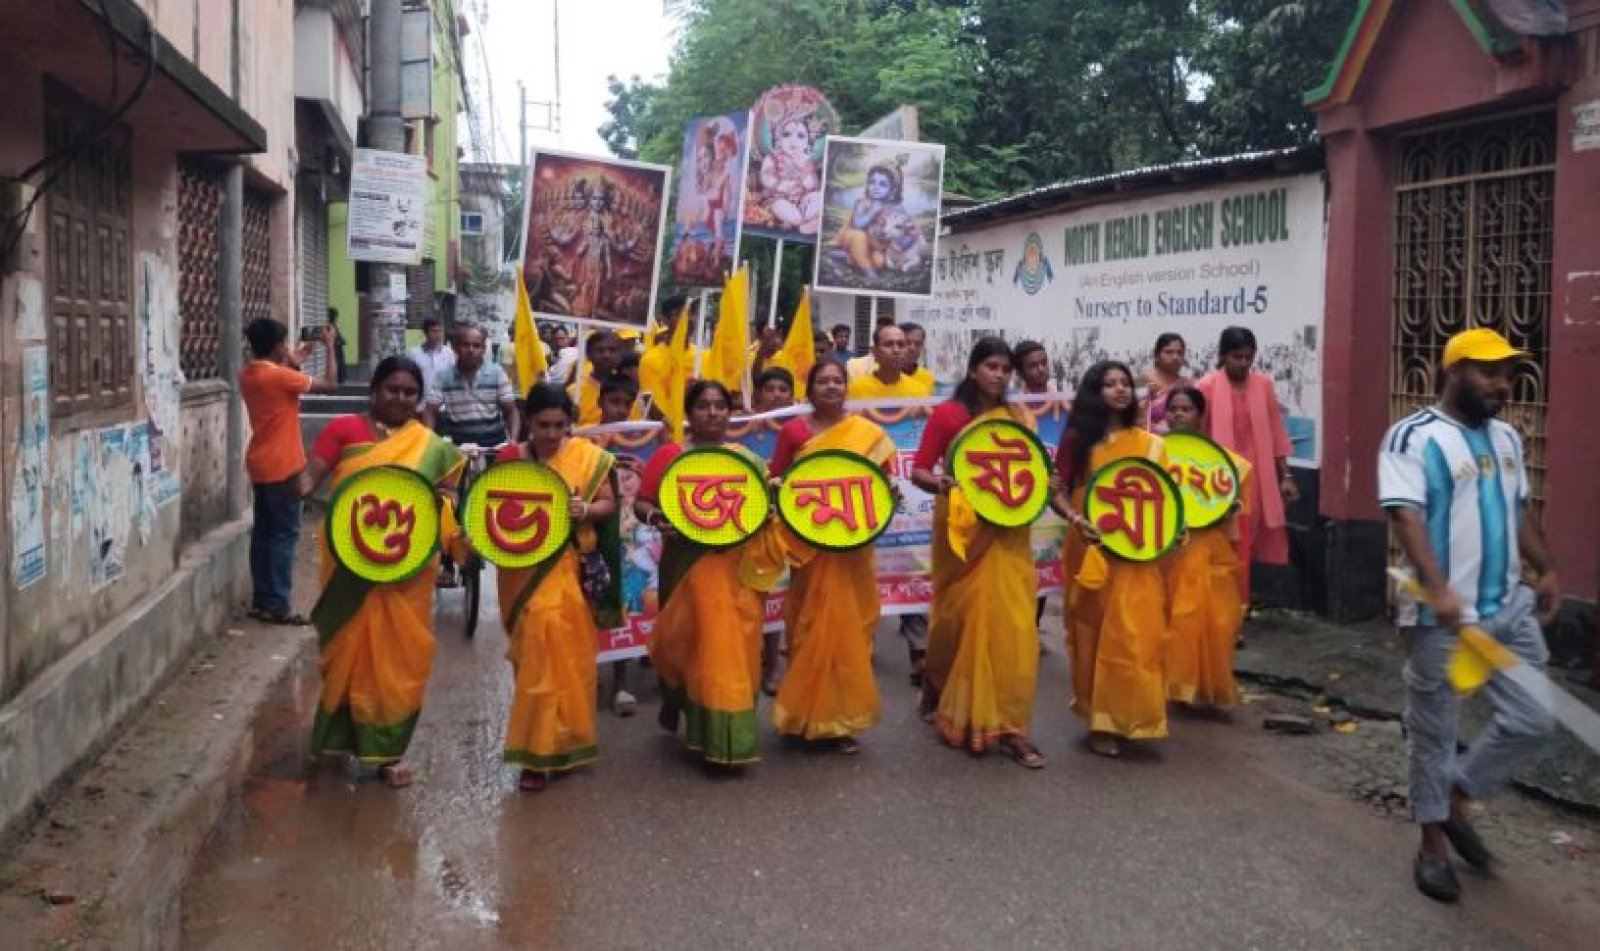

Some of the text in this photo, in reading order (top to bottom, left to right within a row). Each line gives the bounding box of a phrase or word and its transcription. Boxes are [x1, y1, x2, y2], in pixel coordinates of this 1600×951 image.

[1065, 188, 1288, 267] NORTH HERALD ENGLISH SCHOOL
[1074, 285, 1267, 323] Nursery to Standard-5
[1101, 270, 1143, 288] English
[1147, 266, 1195, 283] version
[1201, 258, 1260, 279] School)
[351, 493, 416, 564] শু
[485, 490, 553, 553] ভ
[676, 474, 748, 535] জ
[1096, 467, 1164, 549] মী
